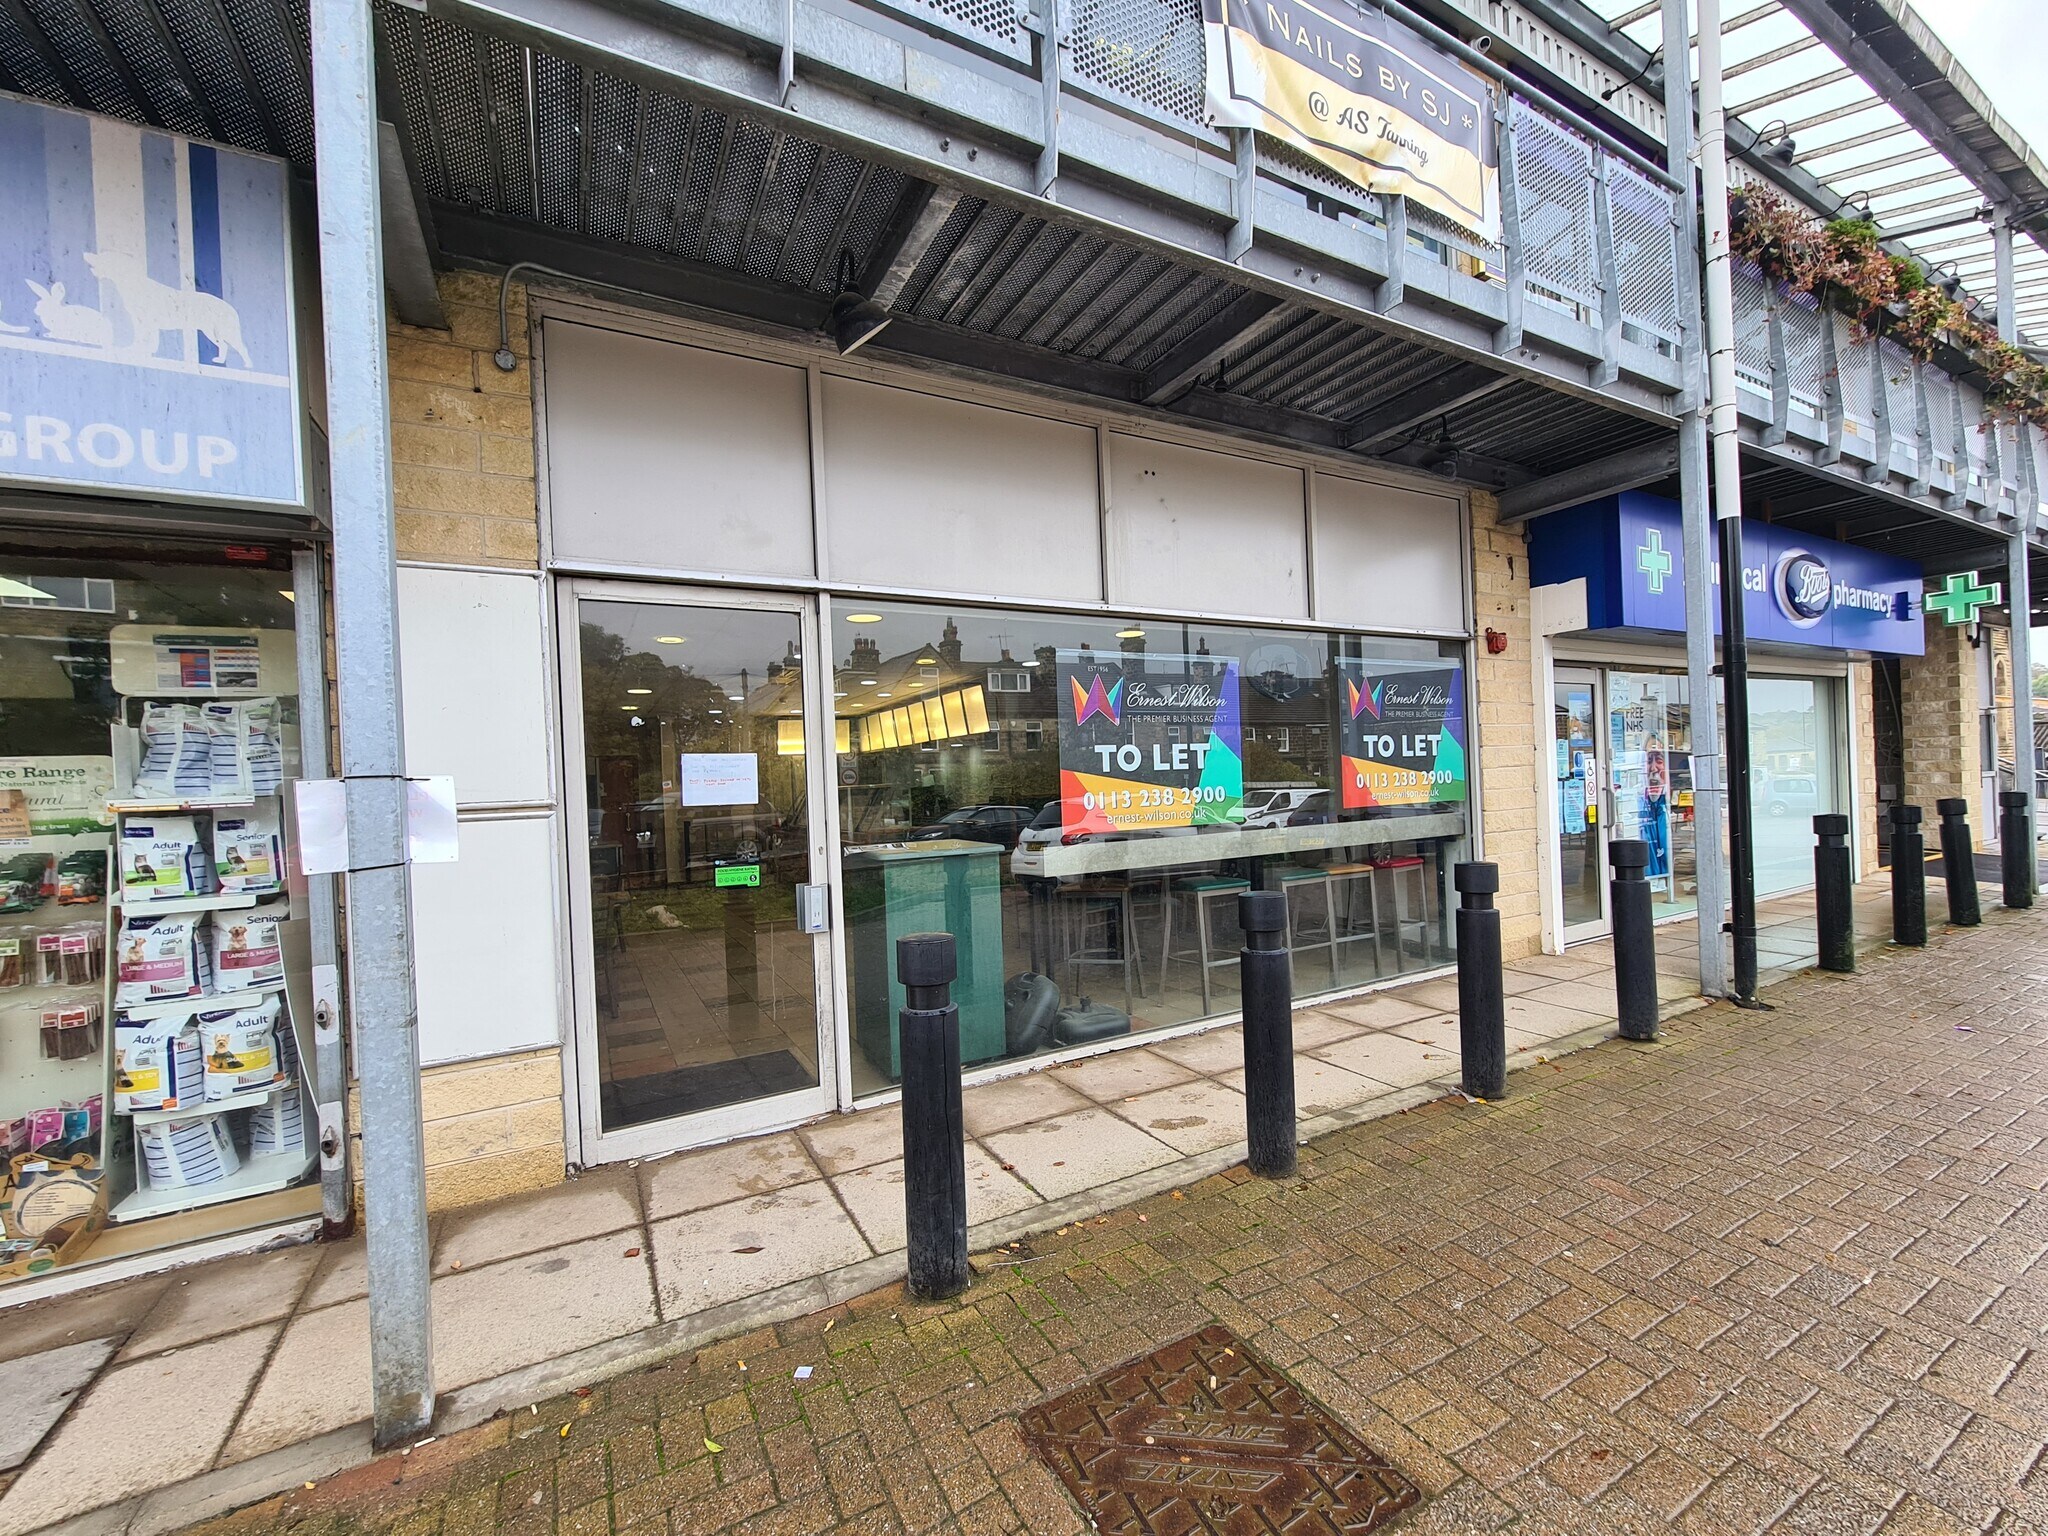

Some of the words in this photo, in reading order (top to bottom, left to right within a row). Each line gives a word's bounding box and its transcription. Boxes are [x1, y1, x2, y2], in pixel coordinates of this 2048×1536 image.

[1267, 3, 1363, 78] NAILS
[1378, 65, 1410, 99] BY
[1421, 89, 1450, 126] SJ
[1308, 91, 1329, 122] @
[1336, 107, 1369, 134] AS
[1377, 115, 1428, 167] Tanning
[1795, 564, 1831, 604] Boots
[1834, 580, 1892, 618] pharmacy
[1127, 682, 1178, 707] Ernest
[1178, 683, 1228, 707] Wilson
[1384, 684, 1420, 705] Ernest
[1420, 685, 1453, 706] Wilson
[1203, 715, 1228, 723] AGENT
[1626, 720, 1644, 733] NHS
[1363, 734, 1395, 758] TO
[1401, 734, 1442, 757] LET
[1094, 743, 1142, 773] TO
[1153, 743, 1211, 771] LET
[23, 767, 86, 780] Range
[1356, 772, 1388, 789] 0113
[1393, 770, 1417, 787] 238
[1421, 769, 1453, 785] 2900
[1083, 791, 1131, 811] 0113
[1139, 788, 1175, 807] 238
[1181, 785, 1226, 805] 2900
[1371, 787, 1440, 800] ernest-wilson.co.uk
[1106, 809, 1208, 825] ernest-wilson.co.uk
[236, 833, 267, 842] Senior
[153, 842, 181, 850] Adult
[152, 924, 184, 936] Adult
[227, 951, 249, 960] LARGE
[153, 960, 183, 970] MEDIUM
[236, 1015, 269, 1029] Adult
